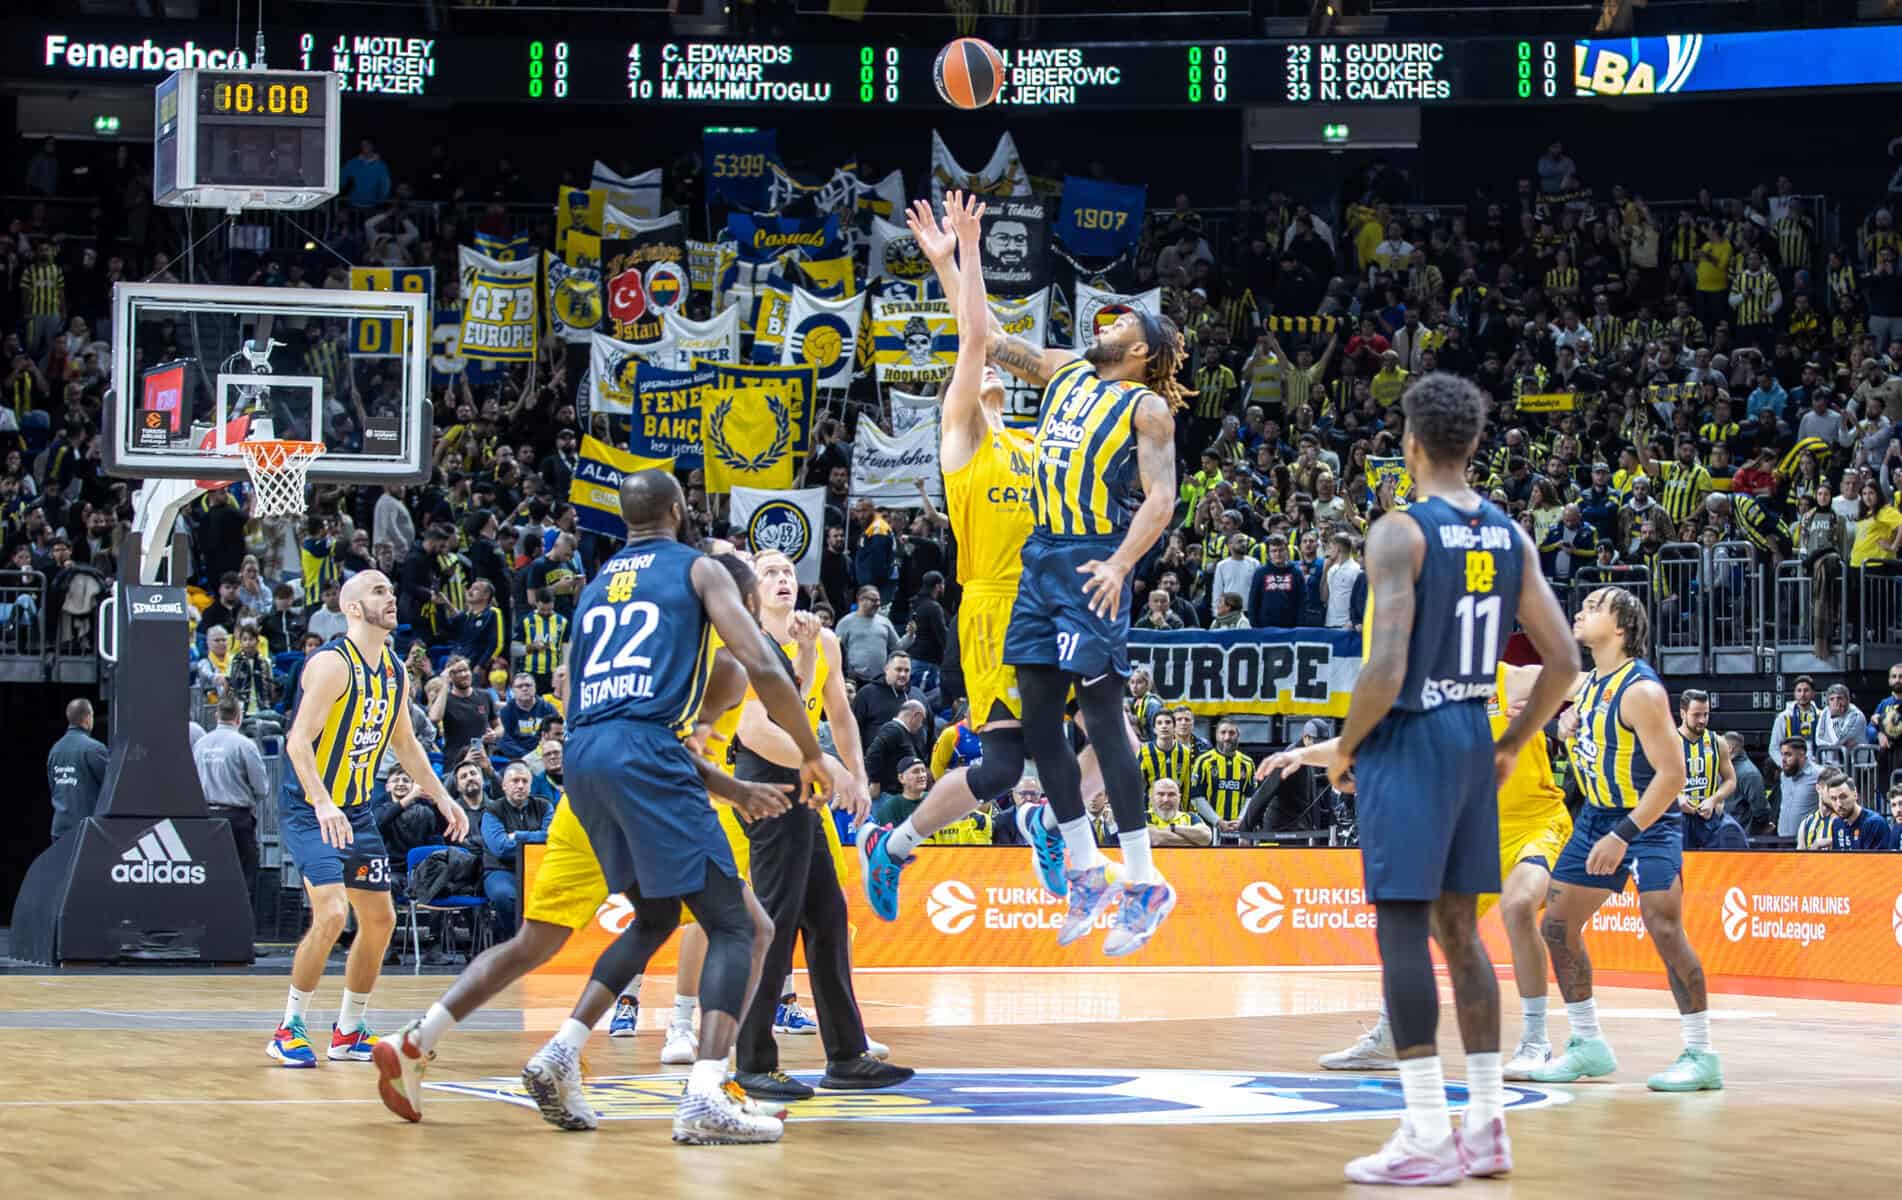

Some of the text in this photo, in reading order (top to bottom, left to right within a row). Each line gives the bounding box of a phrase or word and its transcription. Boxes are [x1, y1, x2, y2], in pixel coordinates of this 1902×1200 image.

[301, 33, 568, 60] 0 J. MOTLEY 0 0
[628, 43, 899, 65] 4 C. EDWARDS 0 0
[1018, 49, 1082, 67] HAYES
[1188, 46, 1202, 65] 0
[1214, 46, 1227, 64] 0
[1286, 41, 1556, 63] 23 M. GUDURIC 0 0
[300, 54, 568, 79] 1 M. BIRSEN 0 0
[628, 62, 642, 80] 5
[860, 66, 874, 83] 0
[886, 66, 899, 83] 0
[1012, 67, 1121, 85] BIBEROVIC
[1188, 65, 1202, 83] 0
[1214, 65, 1227, 83] 0
[1286, 60, 1556, 81] 31 D. BOOKER 0 0
[356, 73, 425, 94] HAZER
[529, 80, 544, 97] 0
[554, 80, 568, 98] 0
[628, 81, 899, 102] 10 M. MAHMUTOGLU 0 0
[1011, 87, 1076, 104] JEKIRI
[1188, 84, 1202, 102] 0
[1214, 84, 1227, 101] 0
[1286, 79, 1556, 100] 33 N. CALATHES 0 0
[222, 83, 309, 114] 10.00
[712, 153, 764, 178] 5399
[1073, 206, 1129, 232] 1907
[752, 228, 828, 249] Casuals
[471, 284, 535, 322] GFB
[881, 302, 950, 317] ISTANBUL
[462, 319, 534, 349] EUROPE
[1062, 385, 1098, 418] 31
[643, 415, 702, 443] BAHÇ
[1046, 413, 1085, 442] beko
[987, 486, 1032, 504] CAZ
[582, 600, 660, 678] 22
[1056, 632, 1080, 661] 31
[1455, 595, 1501, 676] 11
[363, 697, 388, 725] 33
[353, 727, 382, 746] beko
[1686, 756, 1704, 773] 10
[111, 859, 206, 884] adidas
[985, 887, 1062, 905] TURKIS
[1752, 894, 1851, 915] TURKISH AIRLINES
[1292, 907, 1377, 929] EuroLea
[1591, 911, 1645, 940] EuroLeag
[1751, 916, 1826, 947] EuroLeague
